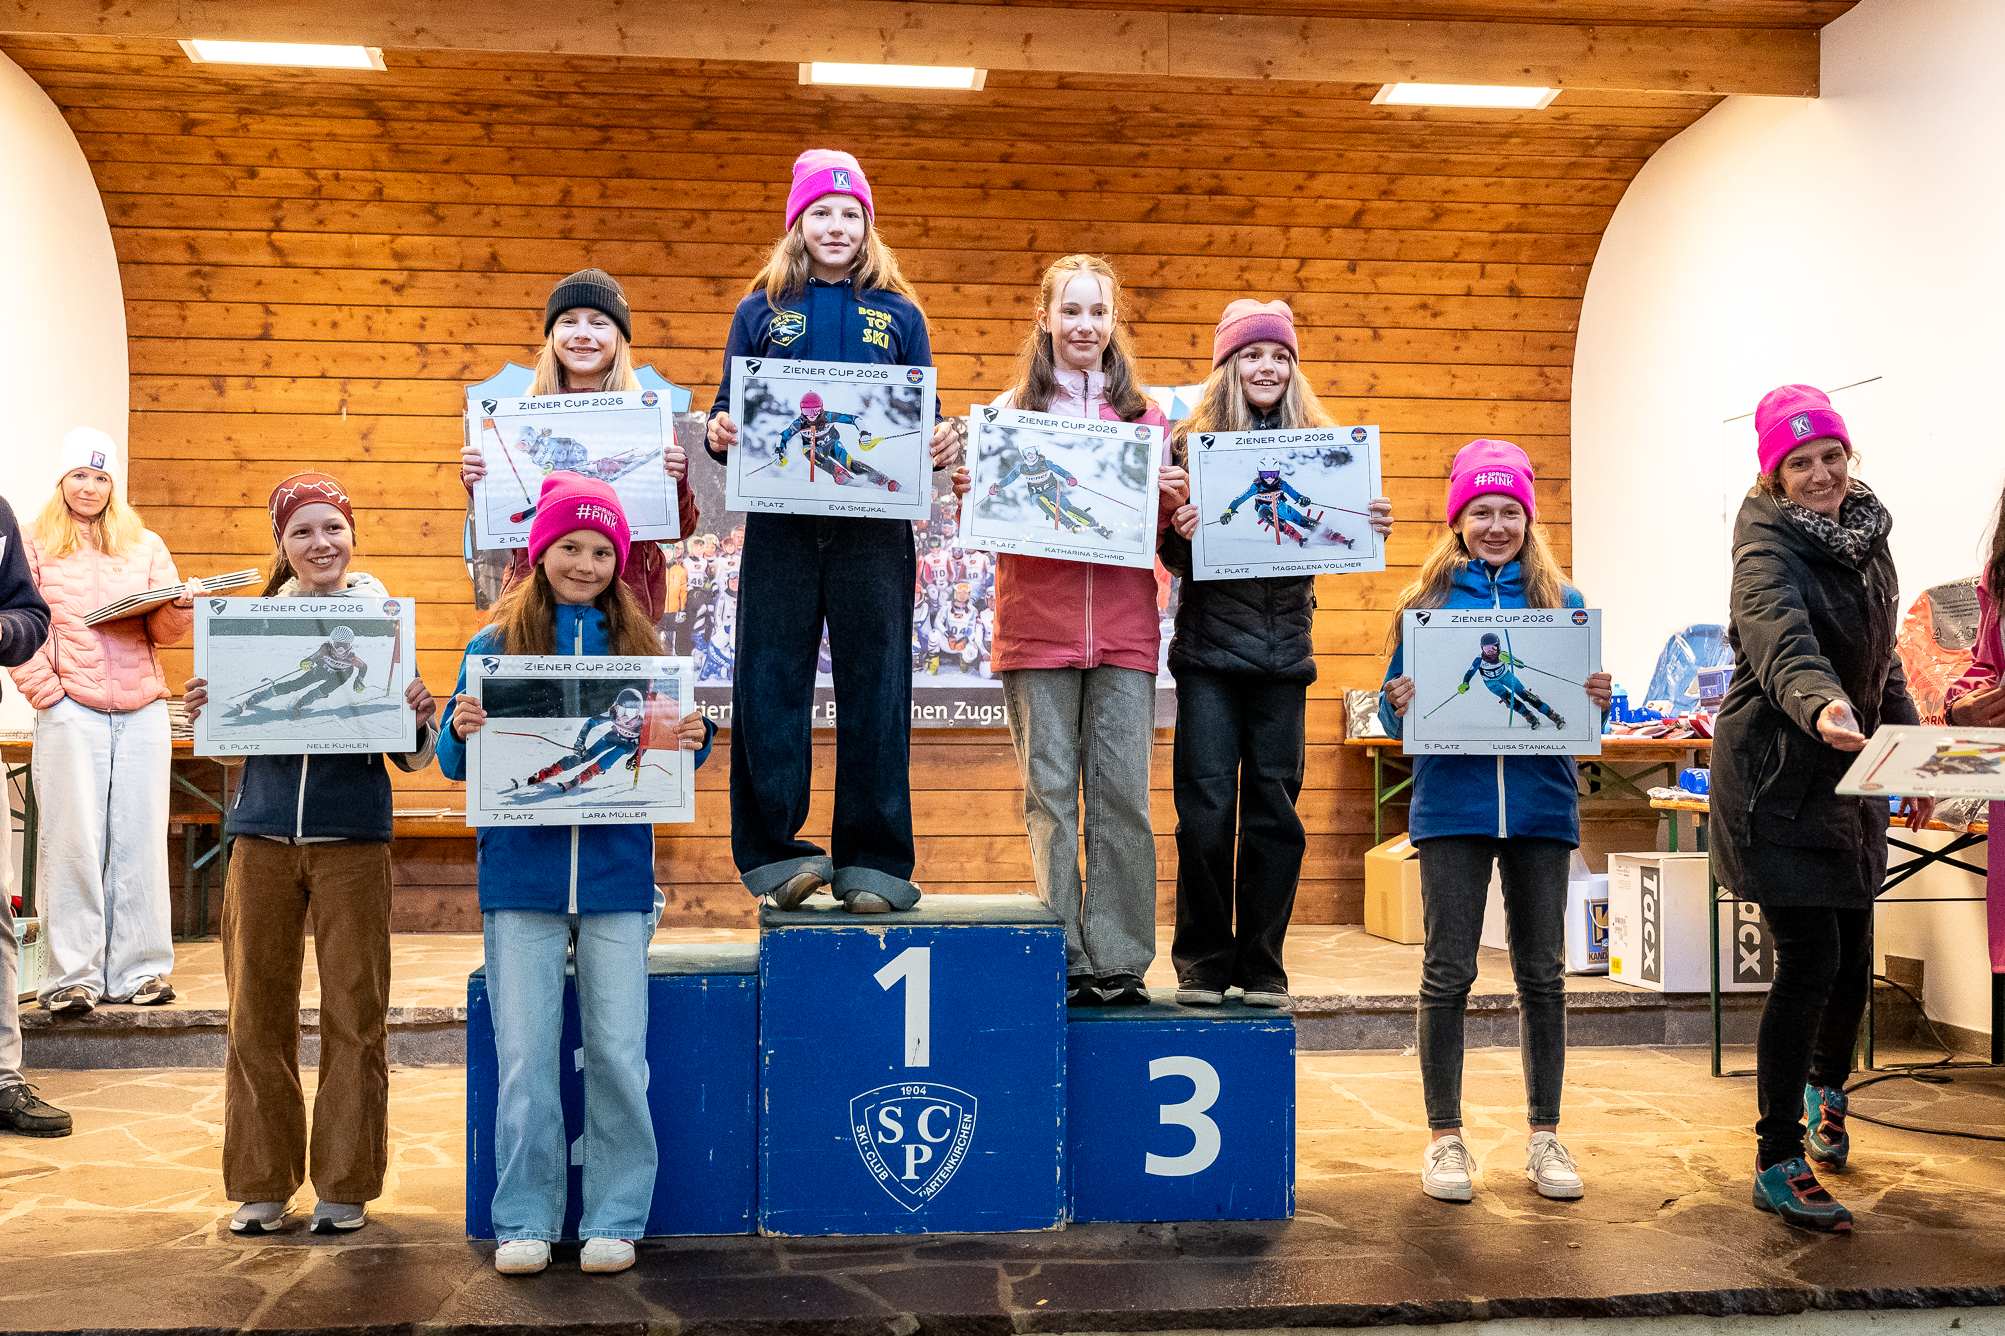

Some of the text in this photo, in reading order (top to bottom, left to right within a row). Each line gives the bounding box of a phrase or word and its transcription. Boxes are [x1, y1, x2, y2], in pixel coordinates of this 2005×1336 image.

[837, 172, 847, 184] K
[858, 307, 892, 323] BORN
[866, 317, 887, 330] TO
[862, 328, 889, 349] SKI
[783, 366, 888, 379] ZIENER CUP 2026
[519, 398, 624, 410] ZIENER CUP 2026
[1018, 416, 1118, 434] ZIENER CUP 2026
[1795, 418, 1808, 433] K
[1235, 433, 1334, 445] ZIENER CUP 2026
[1488, 476, 1514, 488] PINK
[592, 511, 618, 531] PINK
[990, 540, 1016, 549] PLATZ
[1044, 546, 1125, 561] KATHARINA SCHMID
[1272, 564, 1322, 572] MAGDALENA
[250, 604, 364, 613] ZIENER CUP 2026
[1451, 615, 1554, 623] ZIENER CUP 2026
[524, 662, 642, 671] ZIENER CUP 2026
[1643, 874, 1658, 975] Tacx
[1738, 902, 1761, 976] acx
[1589, 952, 1608, 960] KAND
[873, 947, 931, 1068] 1
[901, 1086, 926, 1095] 1904
[1144, 1055, 1222, 1178] 3
[878, 1105, 951, 1144] S C
[901, 1144, 933, 1180] P
